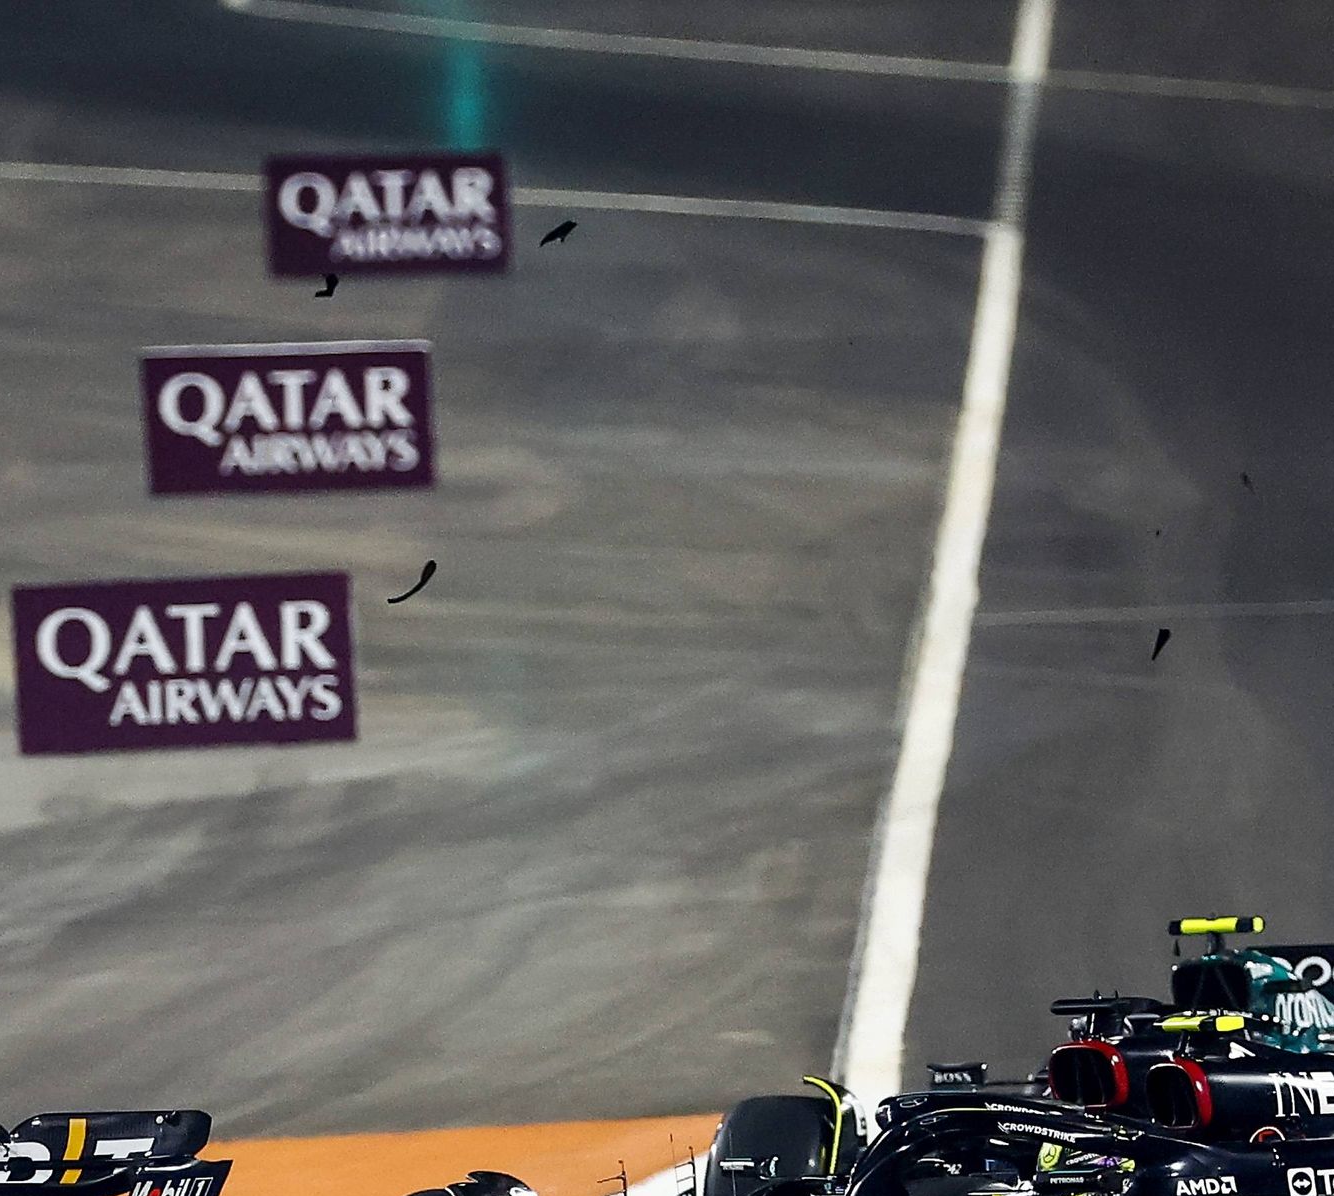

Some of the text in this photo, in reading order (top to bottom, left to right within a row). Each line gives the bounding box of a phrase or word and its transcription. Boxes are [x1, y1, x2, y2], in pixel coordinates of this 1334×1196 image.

[278, 167, 497, 238] QATAR
[330, 226, 503, 262] AIRWAYS
[158, 366, 412, 446] QATAR
[220, 430, 420, 476] AIRWAYS
[36, 601, 338, 692] QATAR
[109, 675, 342, 727] AIRWAYS
[1002, 1122, 1076, 1143] CROWDSTRIKE
[1176, 1178, 1222, 1196] AMD
